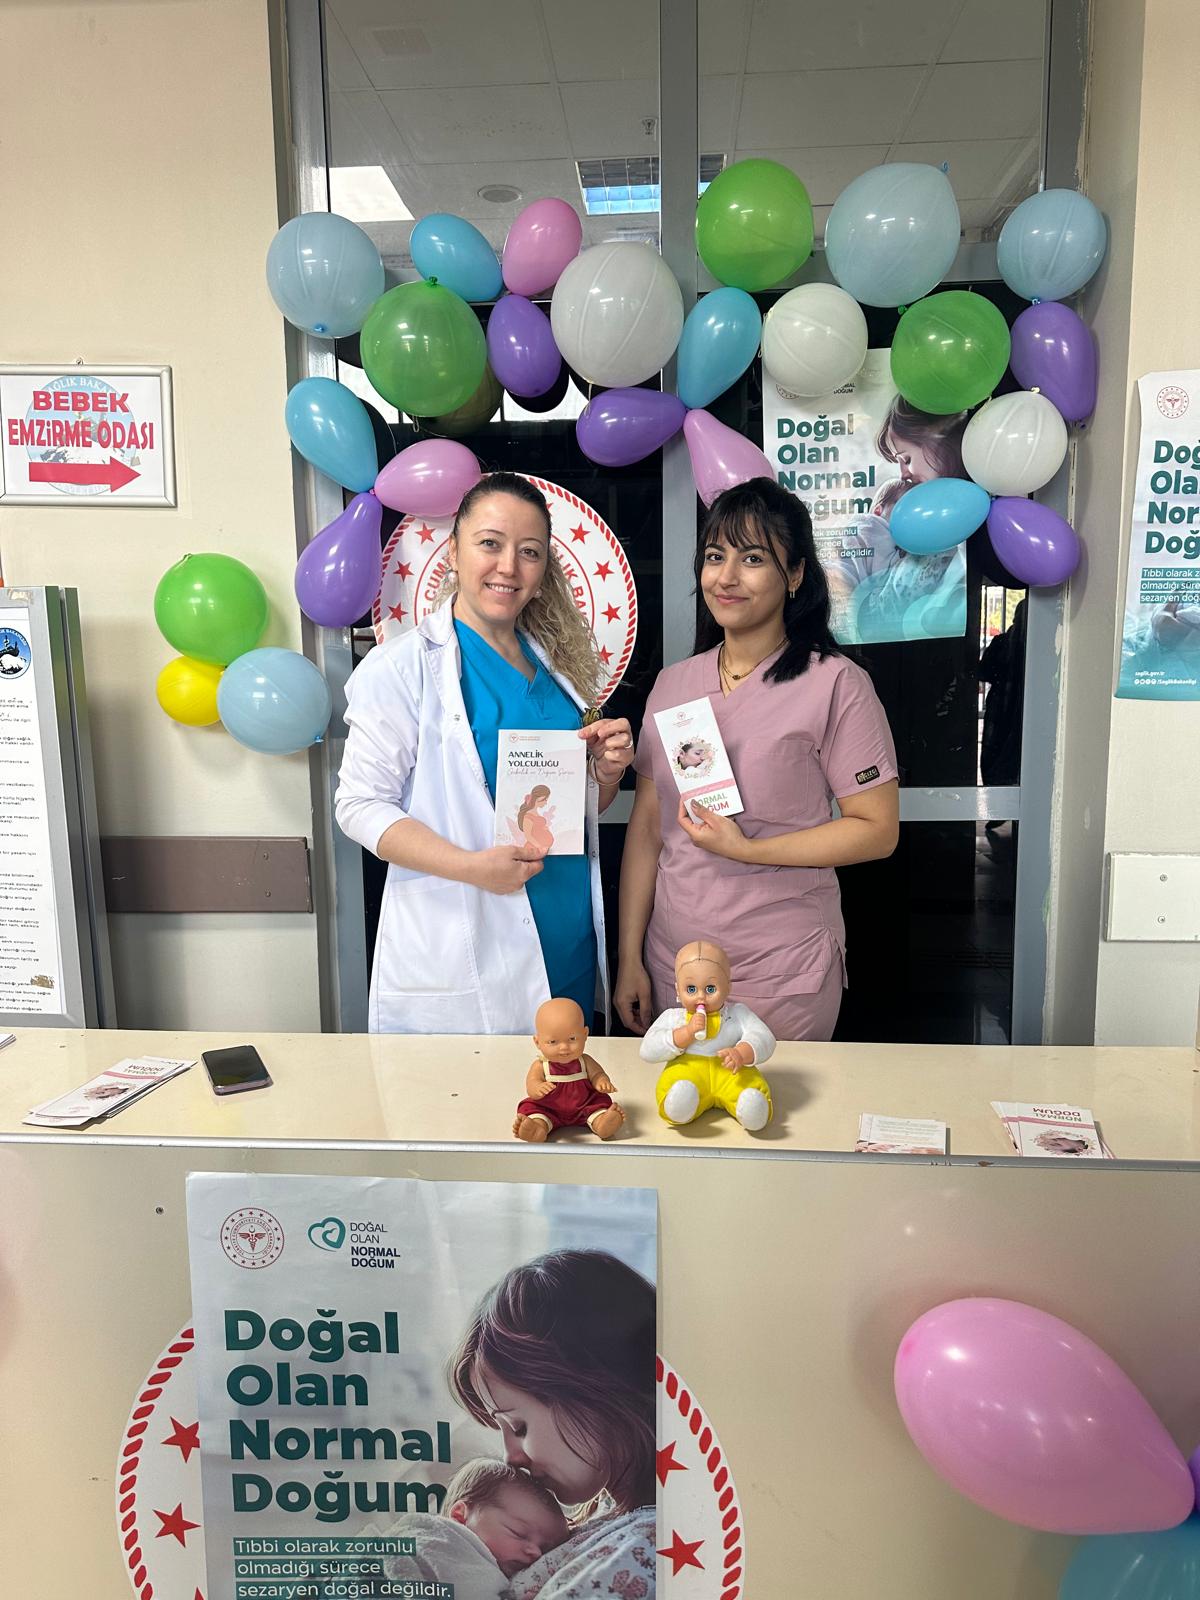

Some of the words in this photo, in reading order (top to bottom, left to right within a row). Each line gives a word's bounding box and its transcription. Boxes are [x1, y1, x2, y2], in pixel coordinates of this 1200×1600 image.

[32, 391, 130, 413] BEBEK
[96, 420, 154, 450] ODASI
[777, 413, 854, 442] Doğal
[777, 442, 840, 465] Olan
[777, 465, 876, 492] Normal
[1150, 470, 1200, 495] Ola
[804, 494, 873, 522] ğum
[1147, 501, 1200, 525] Nor
[1145, 530, 1200, 560] Doğ
[1165, 569, 1193, 577] olarak
[1141, 582, 1179, 591] olmadığı
[1140, 594, 1180, 604] sezaryen
[508, 749, 544, 758] ANNELİK
[508, 759, 559, 768] YOLCULUĞU
[699, 792, 729, 806] ORMAL
[350, 1221, 387, 1233] DOĞAL
[350, 1234, 380, 1244] OLAN
[351, 1246, 401, 1258] NORMAL
[351, 1256, 395, 1269] DOĞUM
[224, 1308, 400, 1363] Doğal
[226, 1362, 369, 1406] Olan
[229, 1419, 452, 1464] Normal
[231, 1471, 448, 1523] Doğum
[235, 1539, 279, 1553] Tıbbi
[284, 1539, 340, 1553] olarak
[345, 1540, 413, 1553] zorunlu
[237, 1560, 314, 1577] olmadığı
[320, 1561, 381, 1574] sürece
[238, 1584, 319, 1599] sezaryen
[324, 1582, 375, 1598] doğal
[380, 1582, 451, 1598] değildir.
